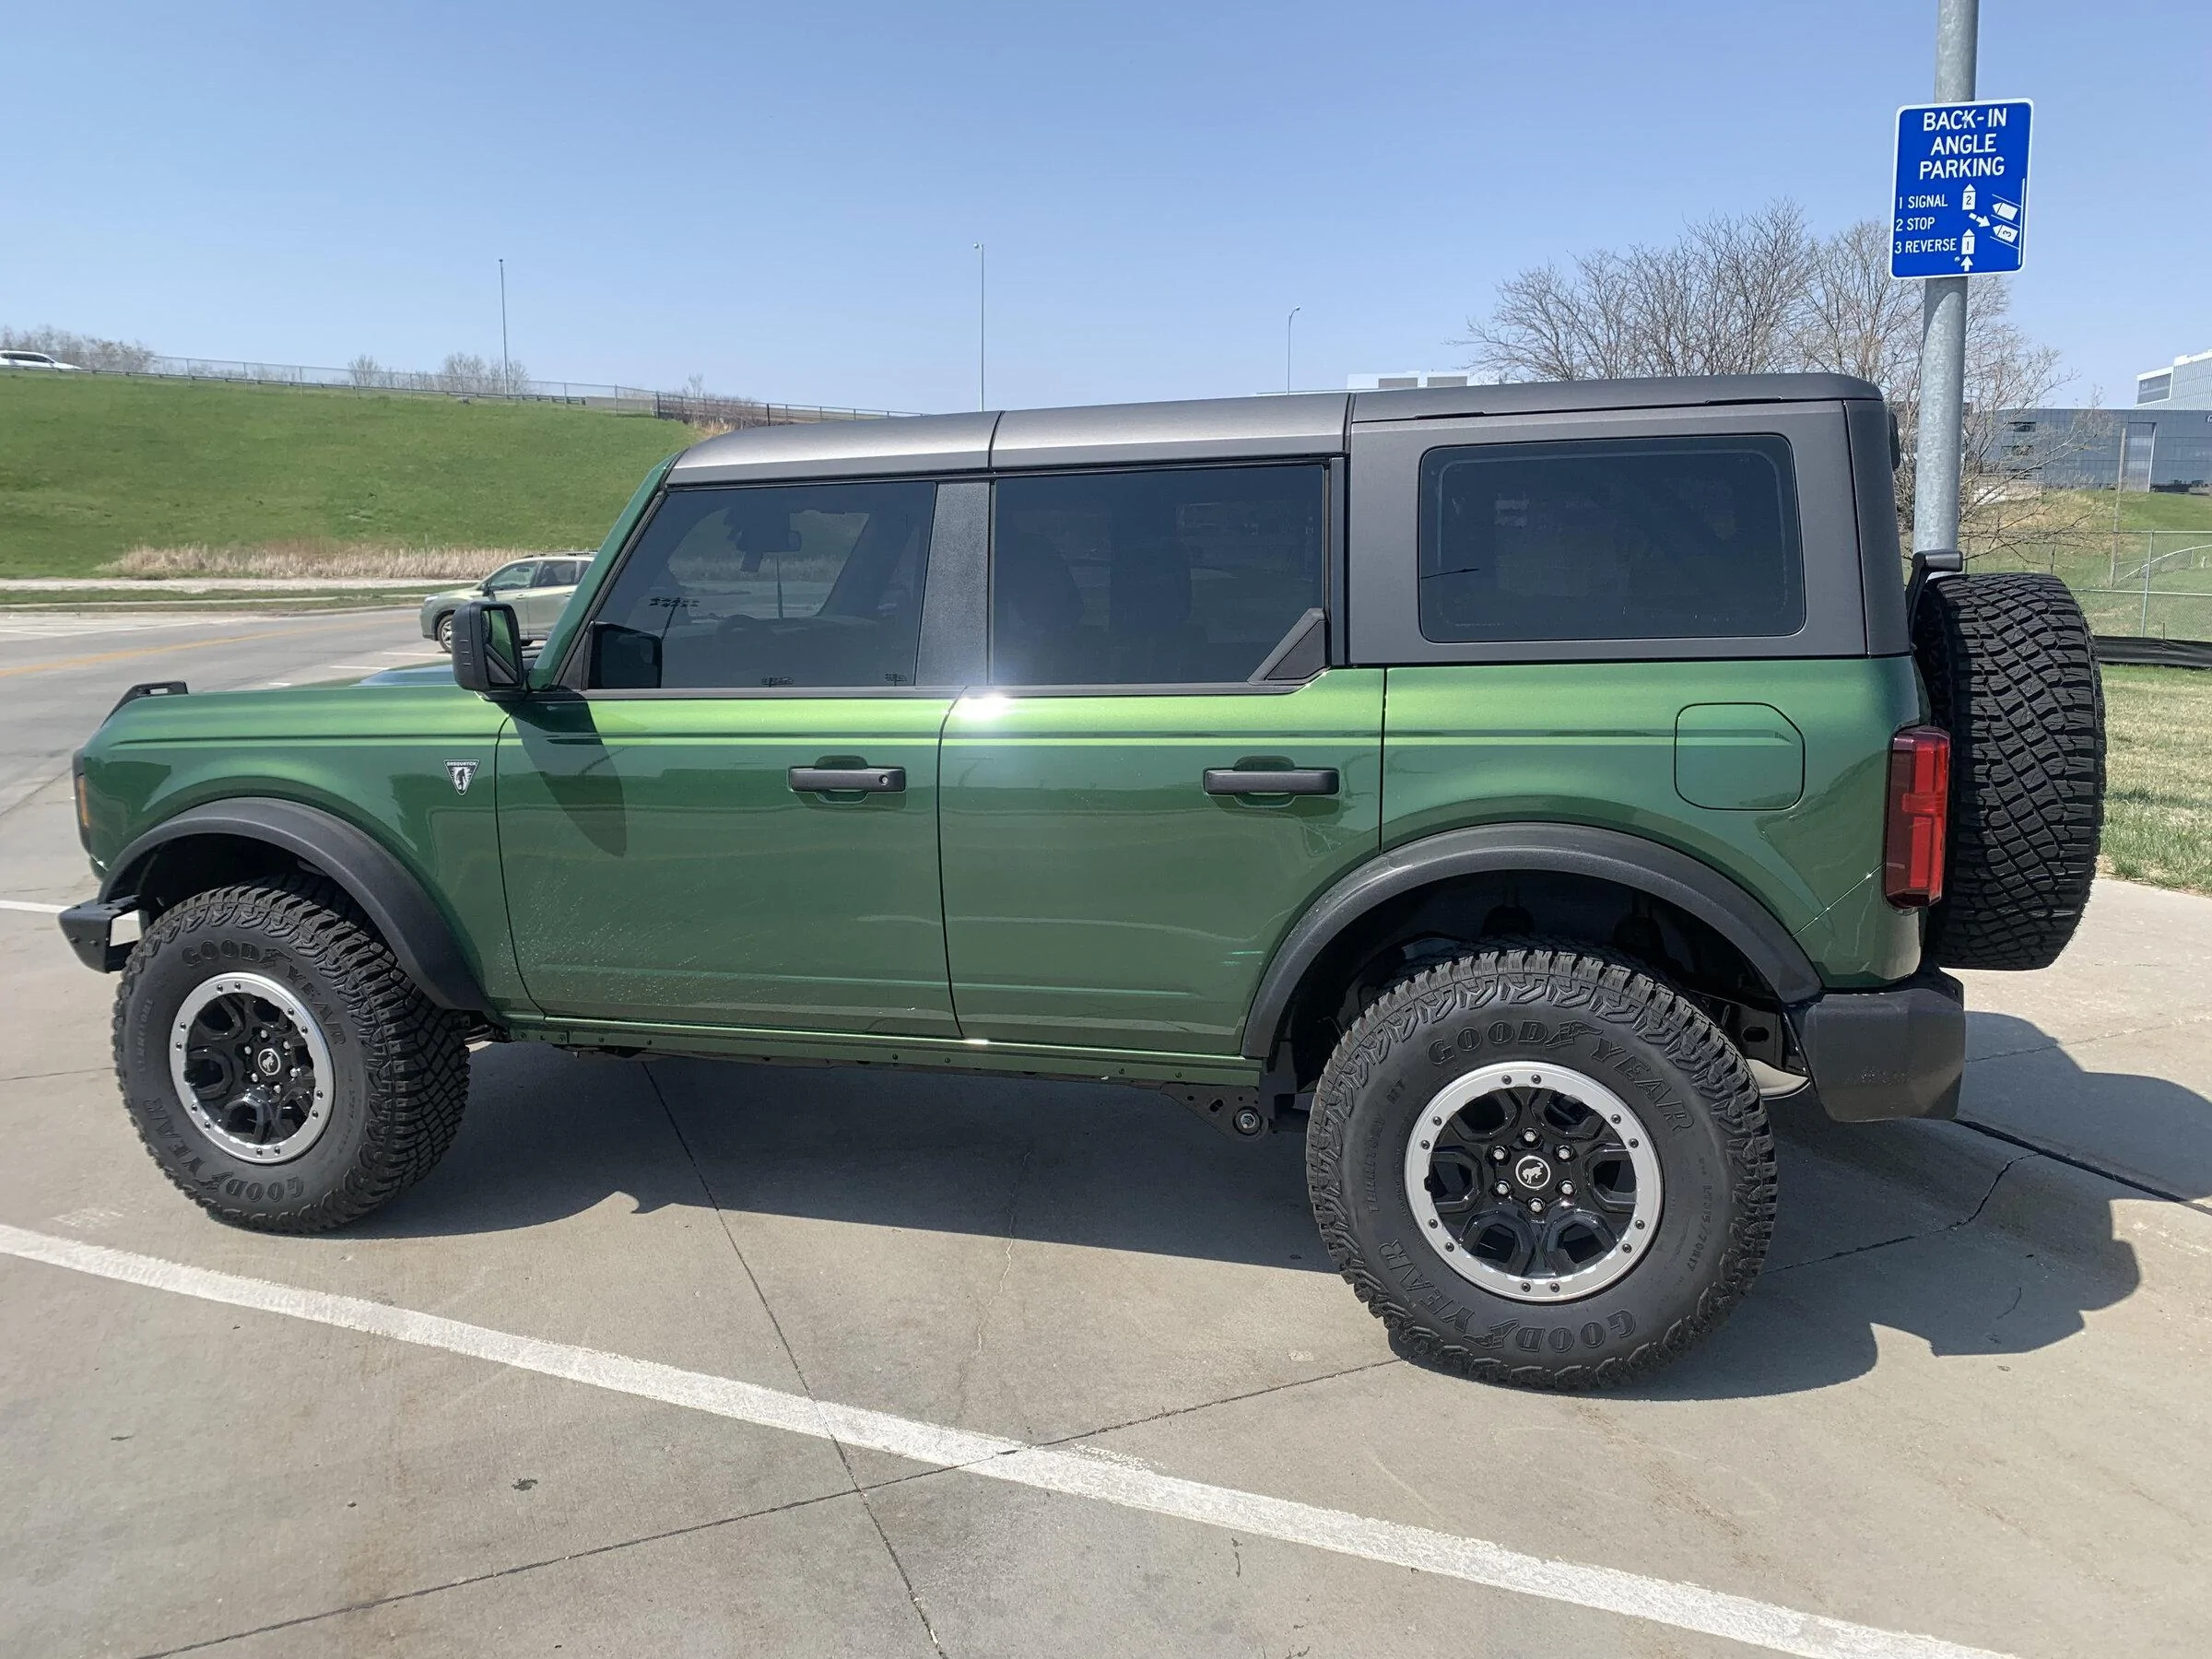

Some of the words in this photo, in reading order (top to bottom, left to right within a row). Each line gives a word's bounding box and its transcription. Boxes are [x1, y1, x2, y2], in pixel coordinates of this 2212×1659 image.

[1924, 108, 2006, 132] BACK-IN
[1930, 133, 1997, 156] ANGLE
[1919, 157, 2005, 180] PARKING
[1899, 196, 1903, 209] 1
[1908, 194, 1948, 209] SIGNAL
[1966, 195, 1972, 206] 2
[1895, 218, 1903, 231] 2
[1907, 217, 1935, 230] STOP
[1894, 241, 1902, 253] 3
[1905, 238, 1957, 253] REVERSE
